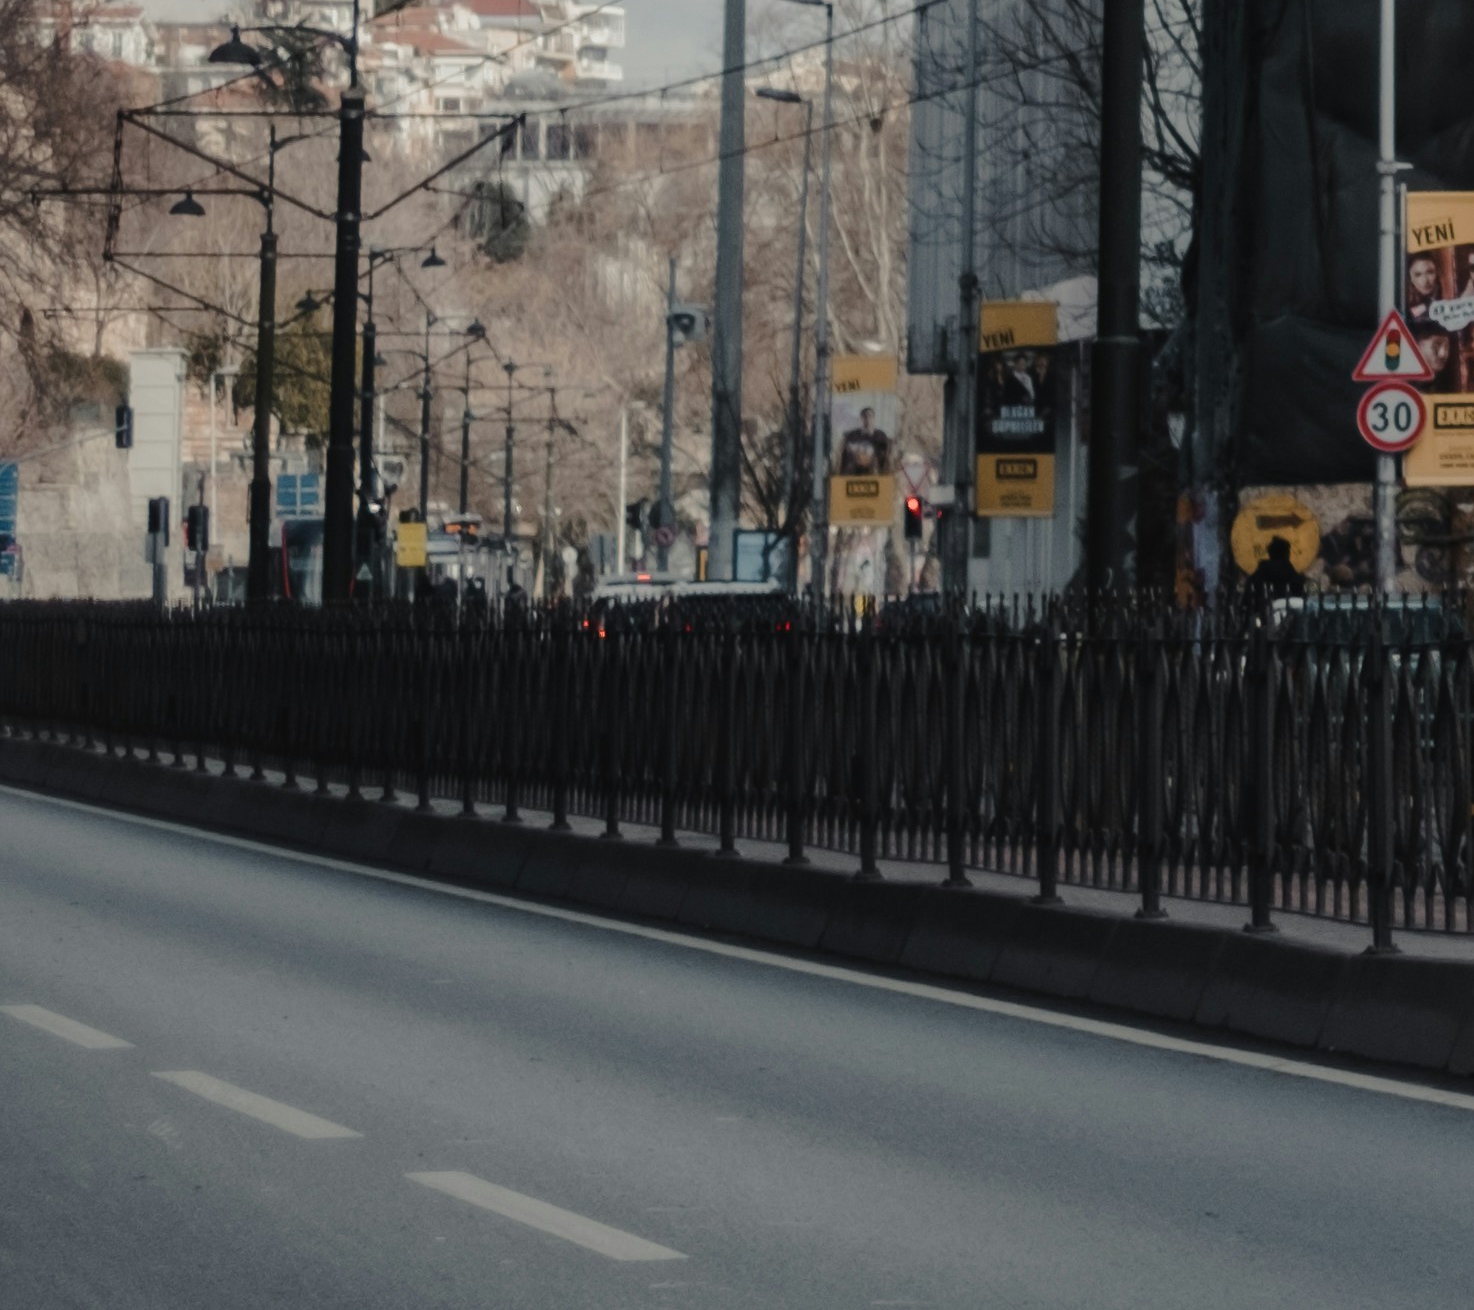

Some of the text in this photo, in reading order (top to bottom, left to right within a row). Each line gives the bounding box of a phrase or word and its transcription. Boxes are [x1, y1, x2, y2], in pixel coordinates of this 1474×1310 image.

[1411, 217, 1455, 247] YENİ
[983, 328, 1015, 348] YENİ
[1371, 402, 1412, 432] 30
